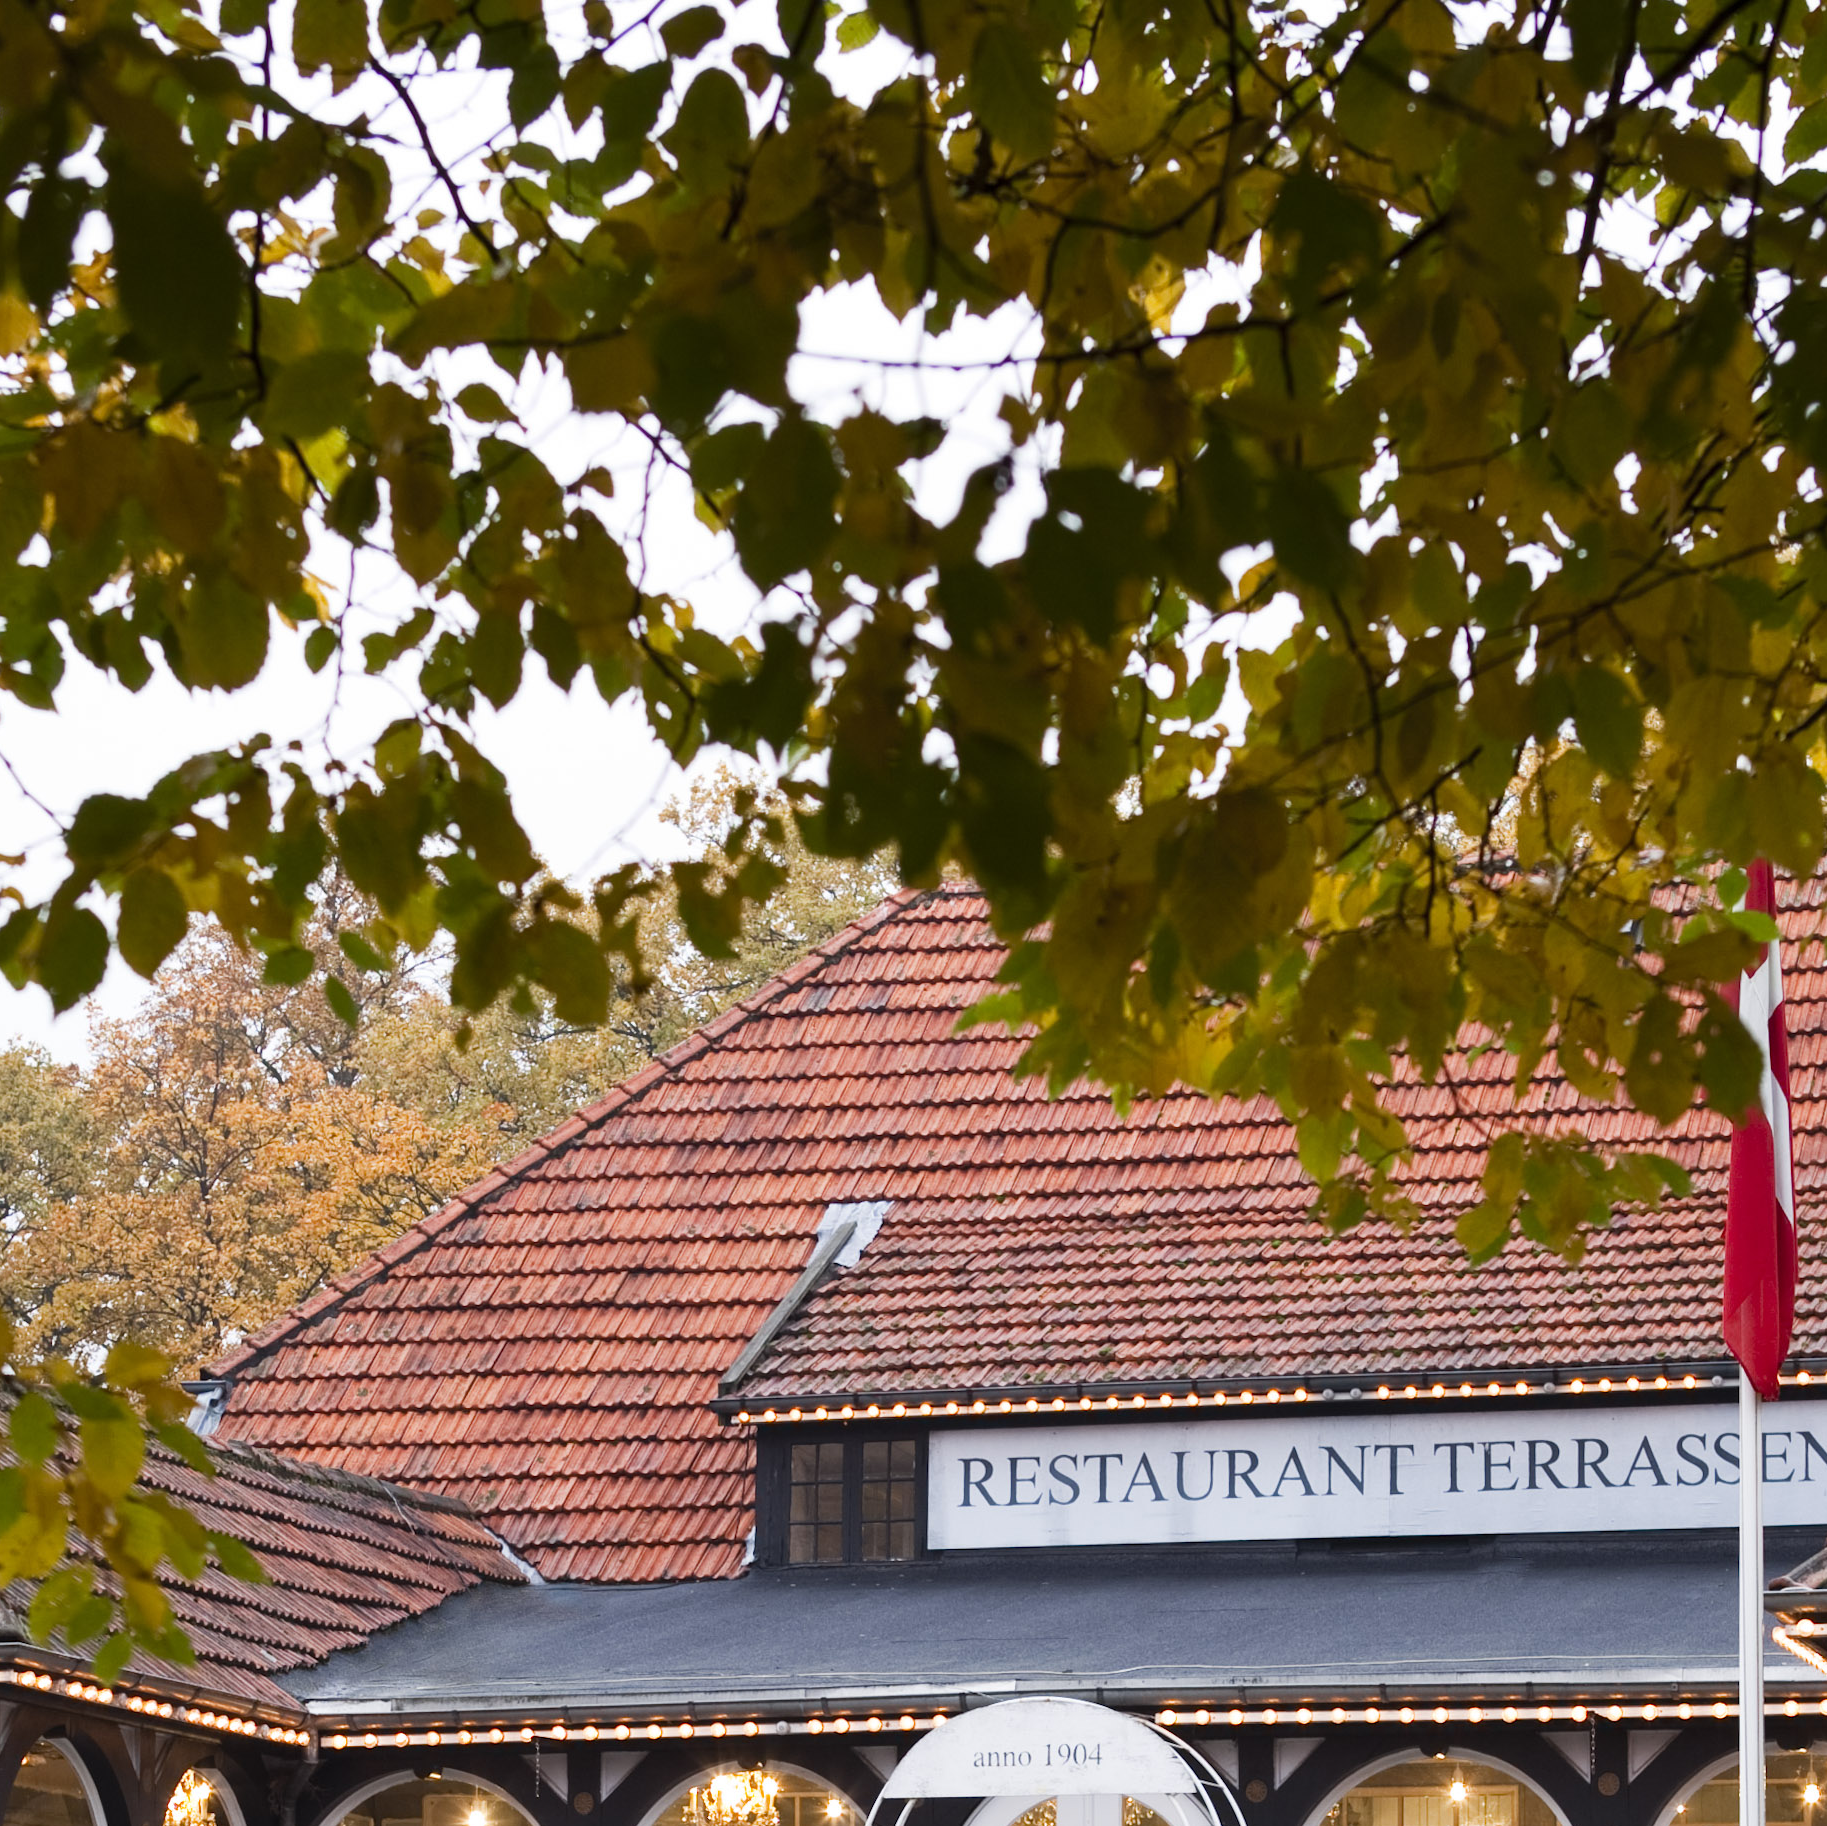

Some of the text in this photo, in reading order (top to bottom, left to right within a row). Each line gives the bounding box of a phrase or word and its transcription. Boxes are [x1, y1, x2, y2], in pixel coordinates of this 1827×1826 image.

[956, 1443, 1415, 1507] RESTAURANT
[972, 1742, 1103, 1768] anno 1904
